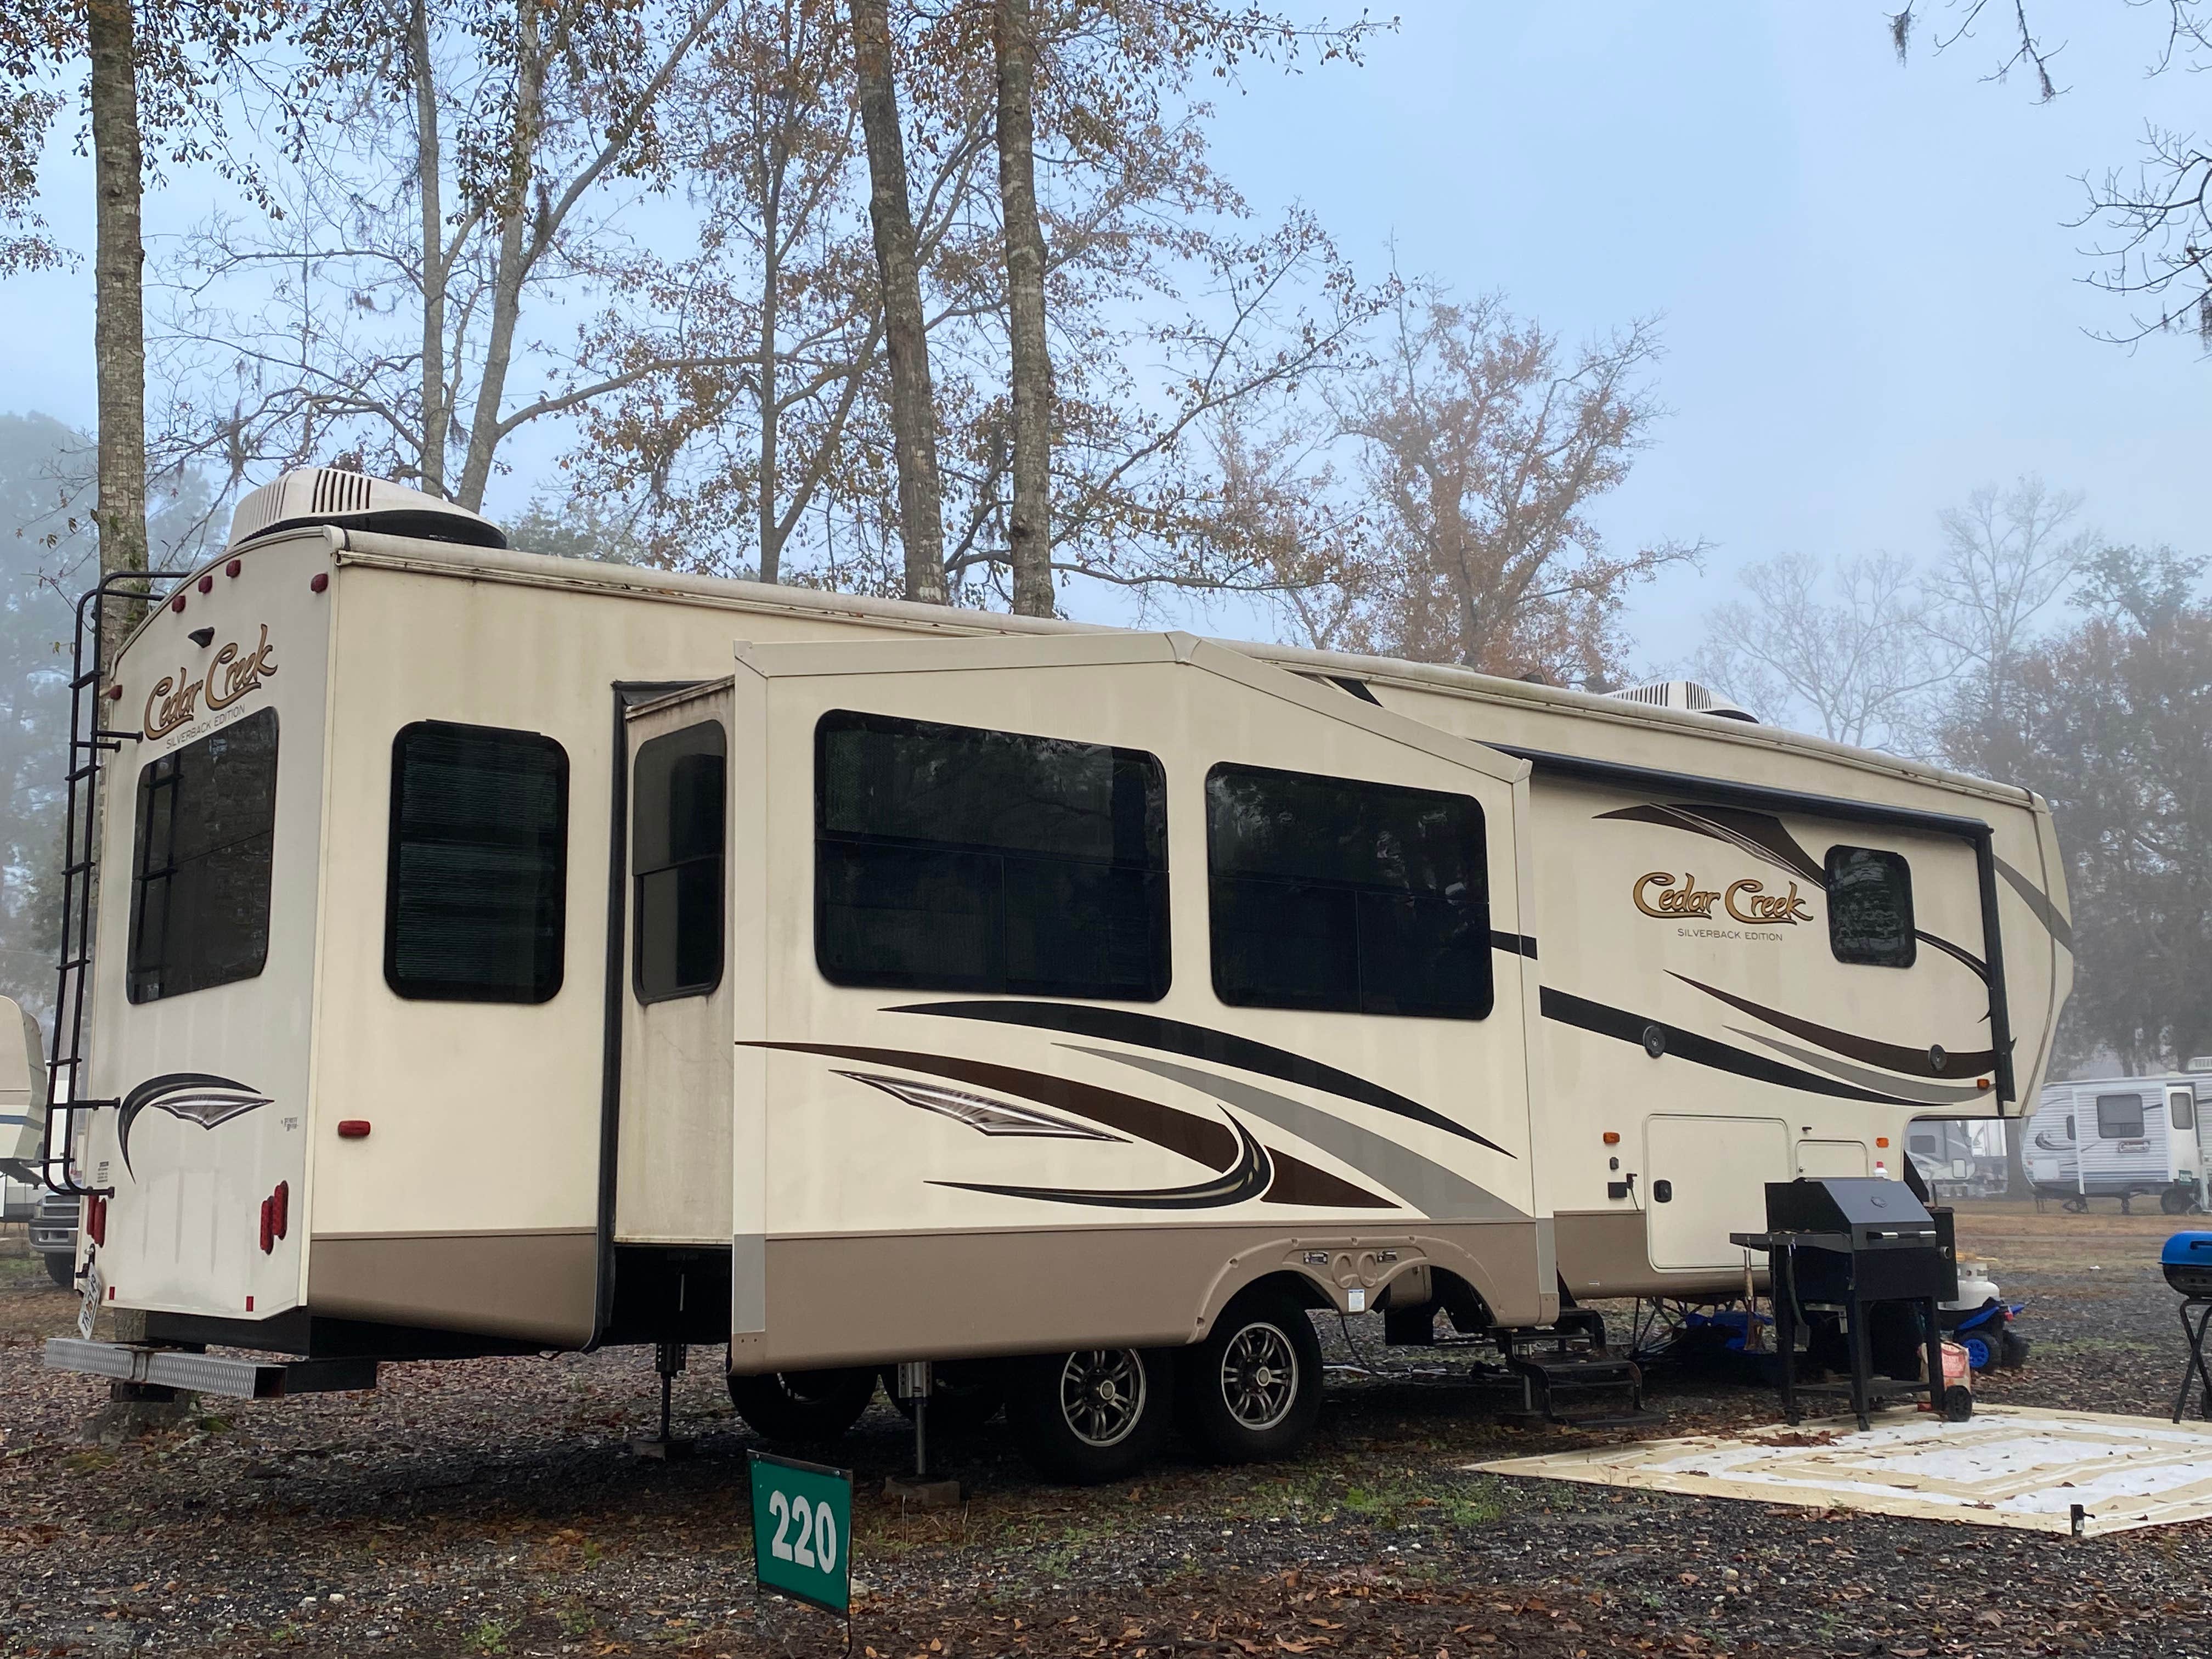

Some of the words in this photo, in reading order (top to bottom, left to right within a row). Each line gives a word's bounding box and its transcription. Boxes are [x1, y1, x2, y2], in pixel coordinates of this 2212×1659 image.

[144, 667, 203, 741] Cedar
[206, 623, 278, 711] Creek
[166, 720, 212, 749] SILVERBACK
[215, 703, 245, 726] EDITION
[1633, 872, 1720, 920] Cedar
[1725, 879, 1814, 926] Creek
[1677, 928, 1741, 939] SILVERBACK
[1745, 932, 1782, 941] EDITION
[769, 1490, 837, 1573] 220
